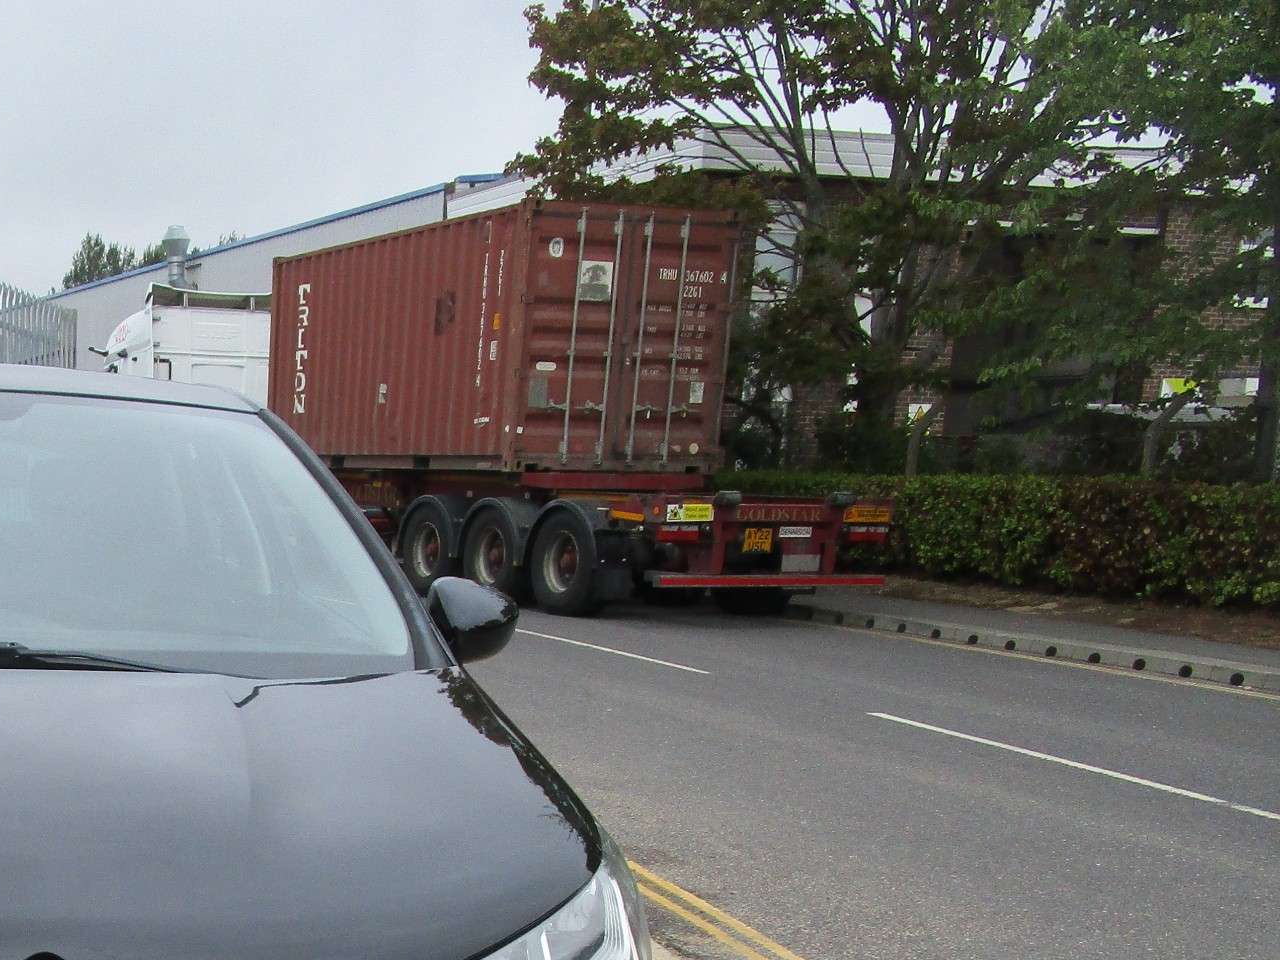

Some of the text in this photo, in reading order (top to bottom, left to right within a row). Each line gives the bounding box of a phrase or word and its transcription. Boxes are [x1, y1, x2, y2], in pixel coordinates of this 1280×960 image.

[659, 268, 728, 284] TRHU 367602 4
[293, 283, 311, 414] TRITON
[736, 507, 821, 522] GOLDSTAR
